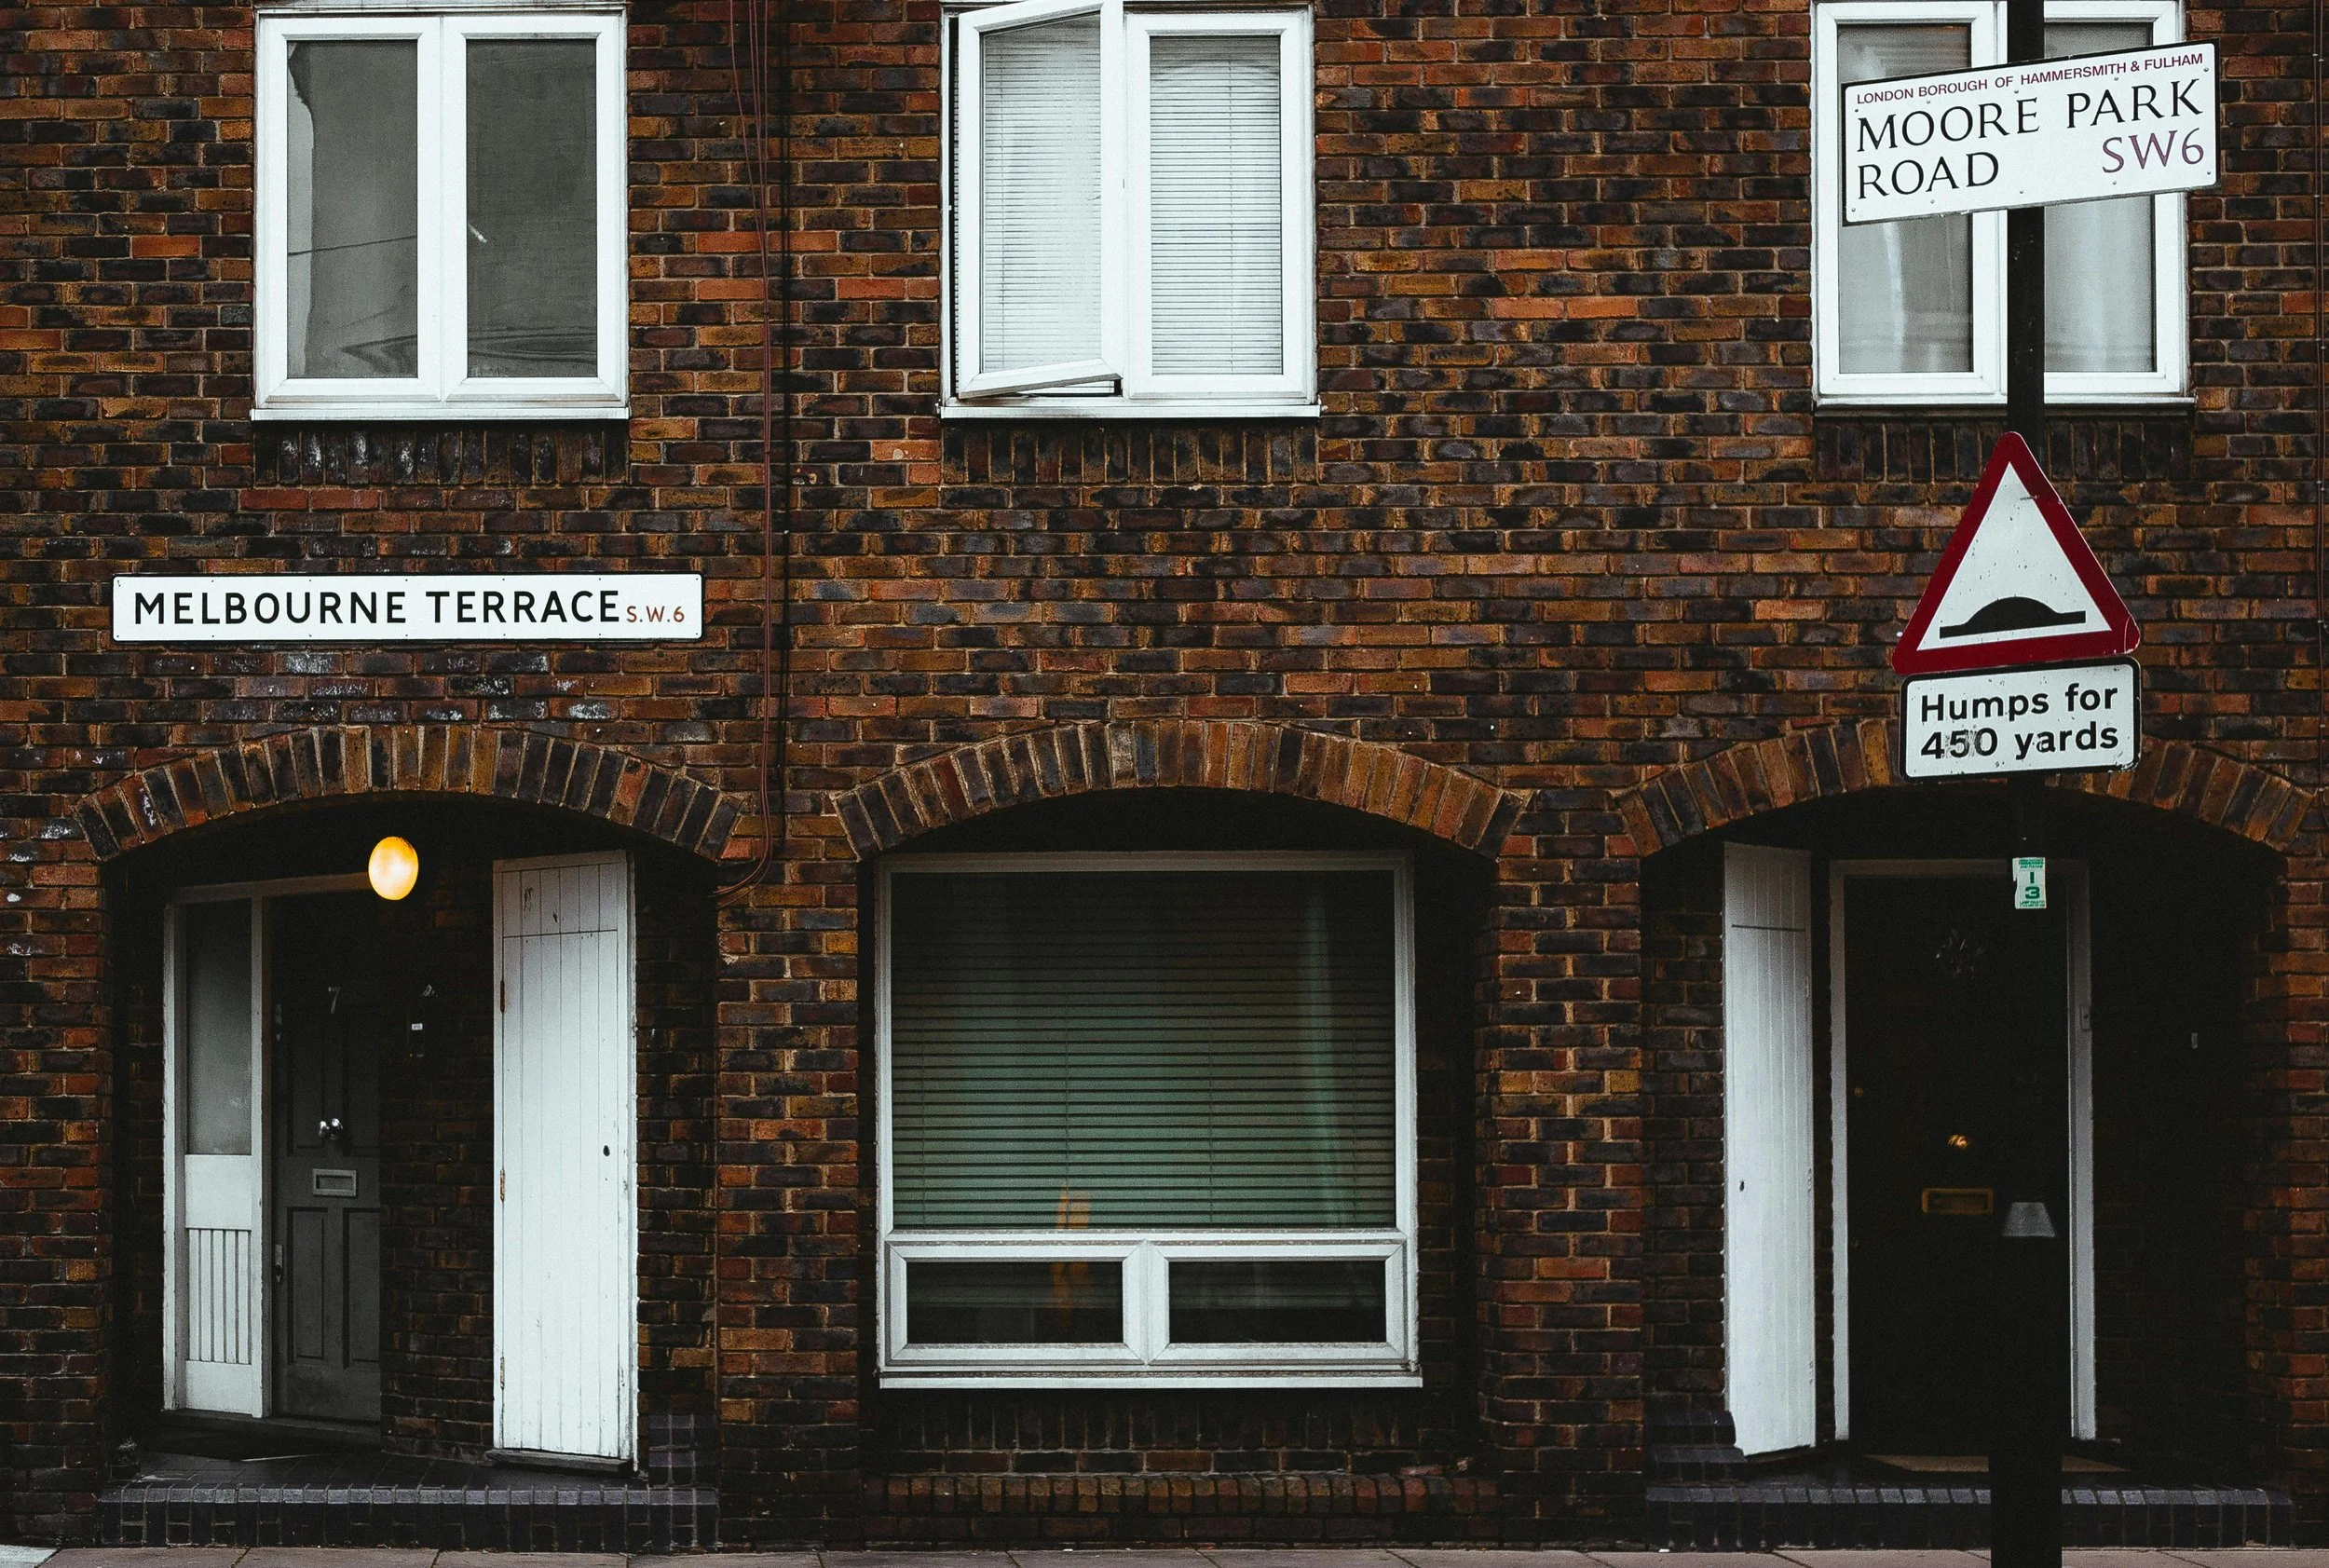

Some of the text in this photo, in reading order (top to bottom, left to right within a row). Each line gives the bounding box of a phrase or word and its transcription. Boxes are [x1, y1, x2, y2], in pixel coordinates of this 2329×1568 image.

[1858, 53, 2202, 103] LONDON BOROUGH OF HAMMERSMITH & FULHAM
[1858, 79, 2202, 152] MOORE PARK
[1859, 128, 2203, 199] ROAD SW6
[135, 591, 684, 624] MELBOURNE TERRACE S.W.6
[1921, 683, 2118, 721] Humps for
[1921, 721, 2118, 760] 450 yards
[328, 986, 341, 1014] 7
